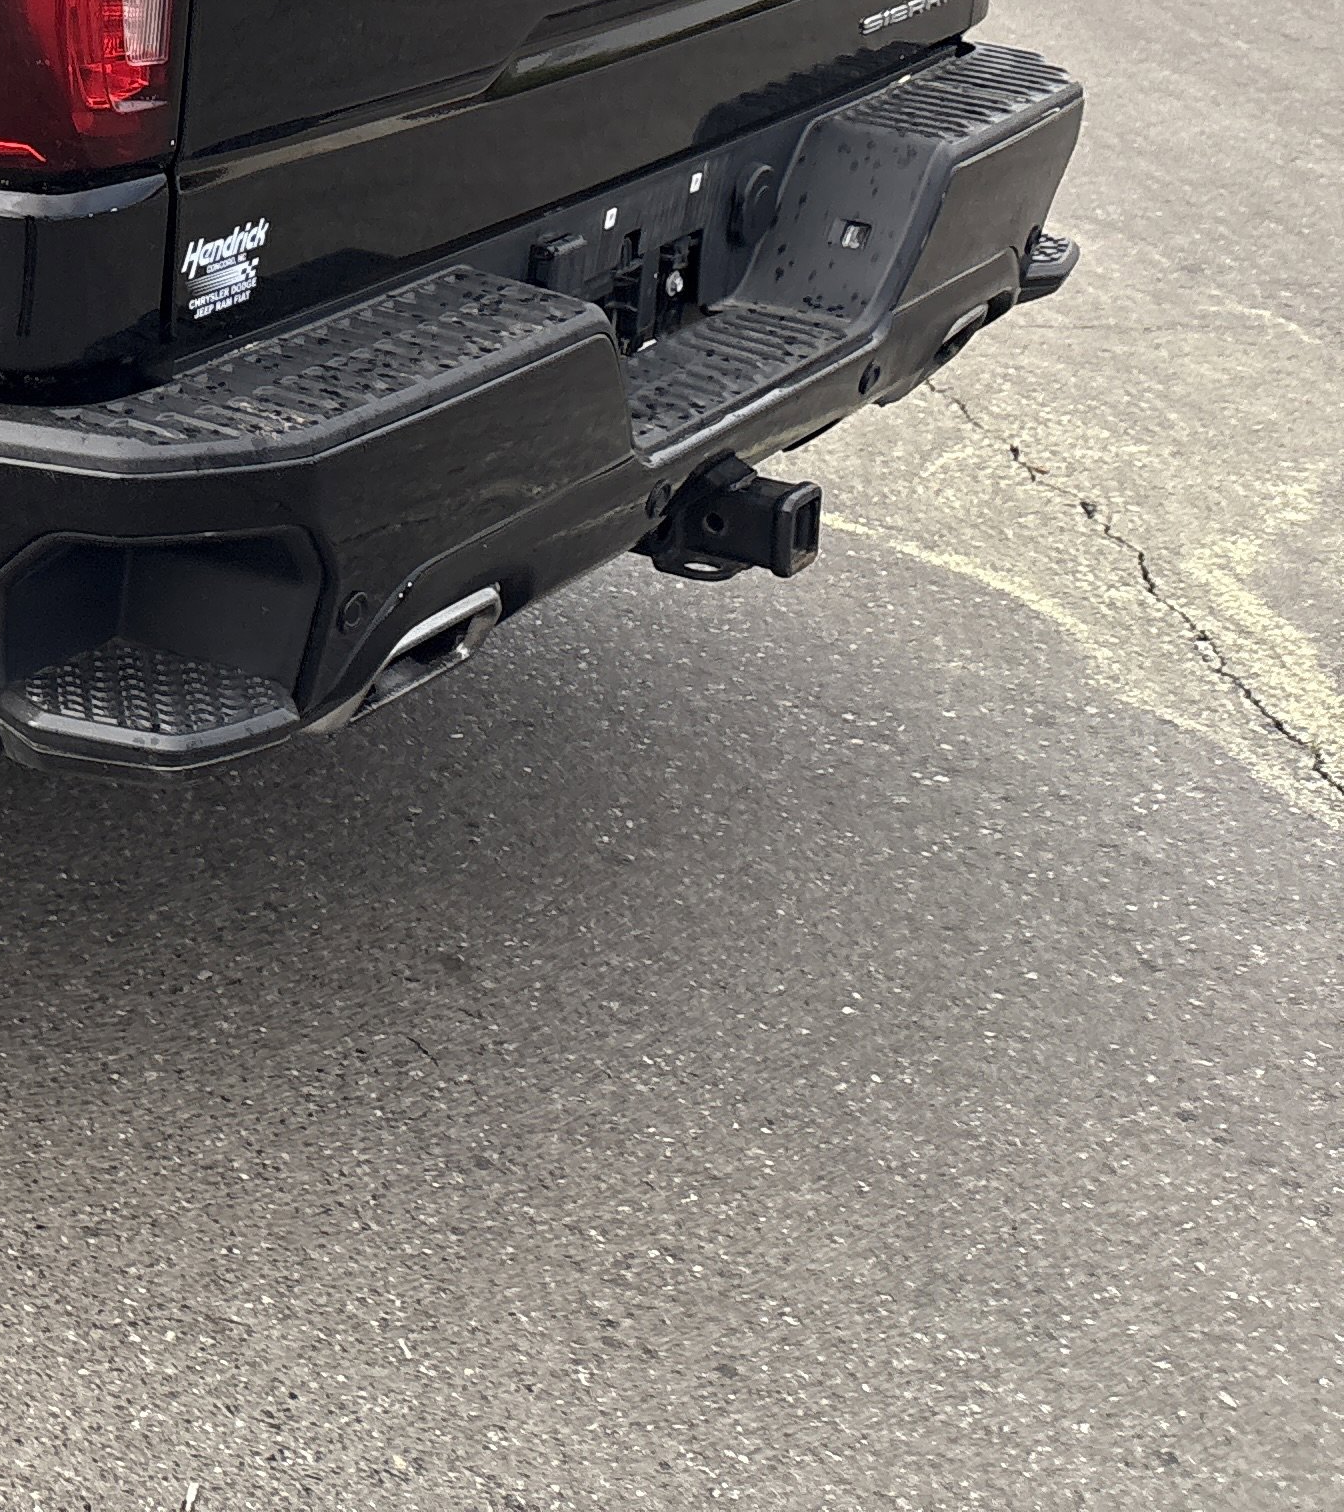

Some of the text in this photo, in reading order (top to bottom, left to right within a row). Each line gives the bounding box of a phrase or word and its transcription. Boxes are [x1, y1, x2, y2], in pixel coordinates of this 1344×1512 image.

[181, 217, 269, 279] Hendrick
[188, 276, 257, 310] CHRYSLER DODGE
[194, 289, 251, 320] JEEP RAM FIAT
